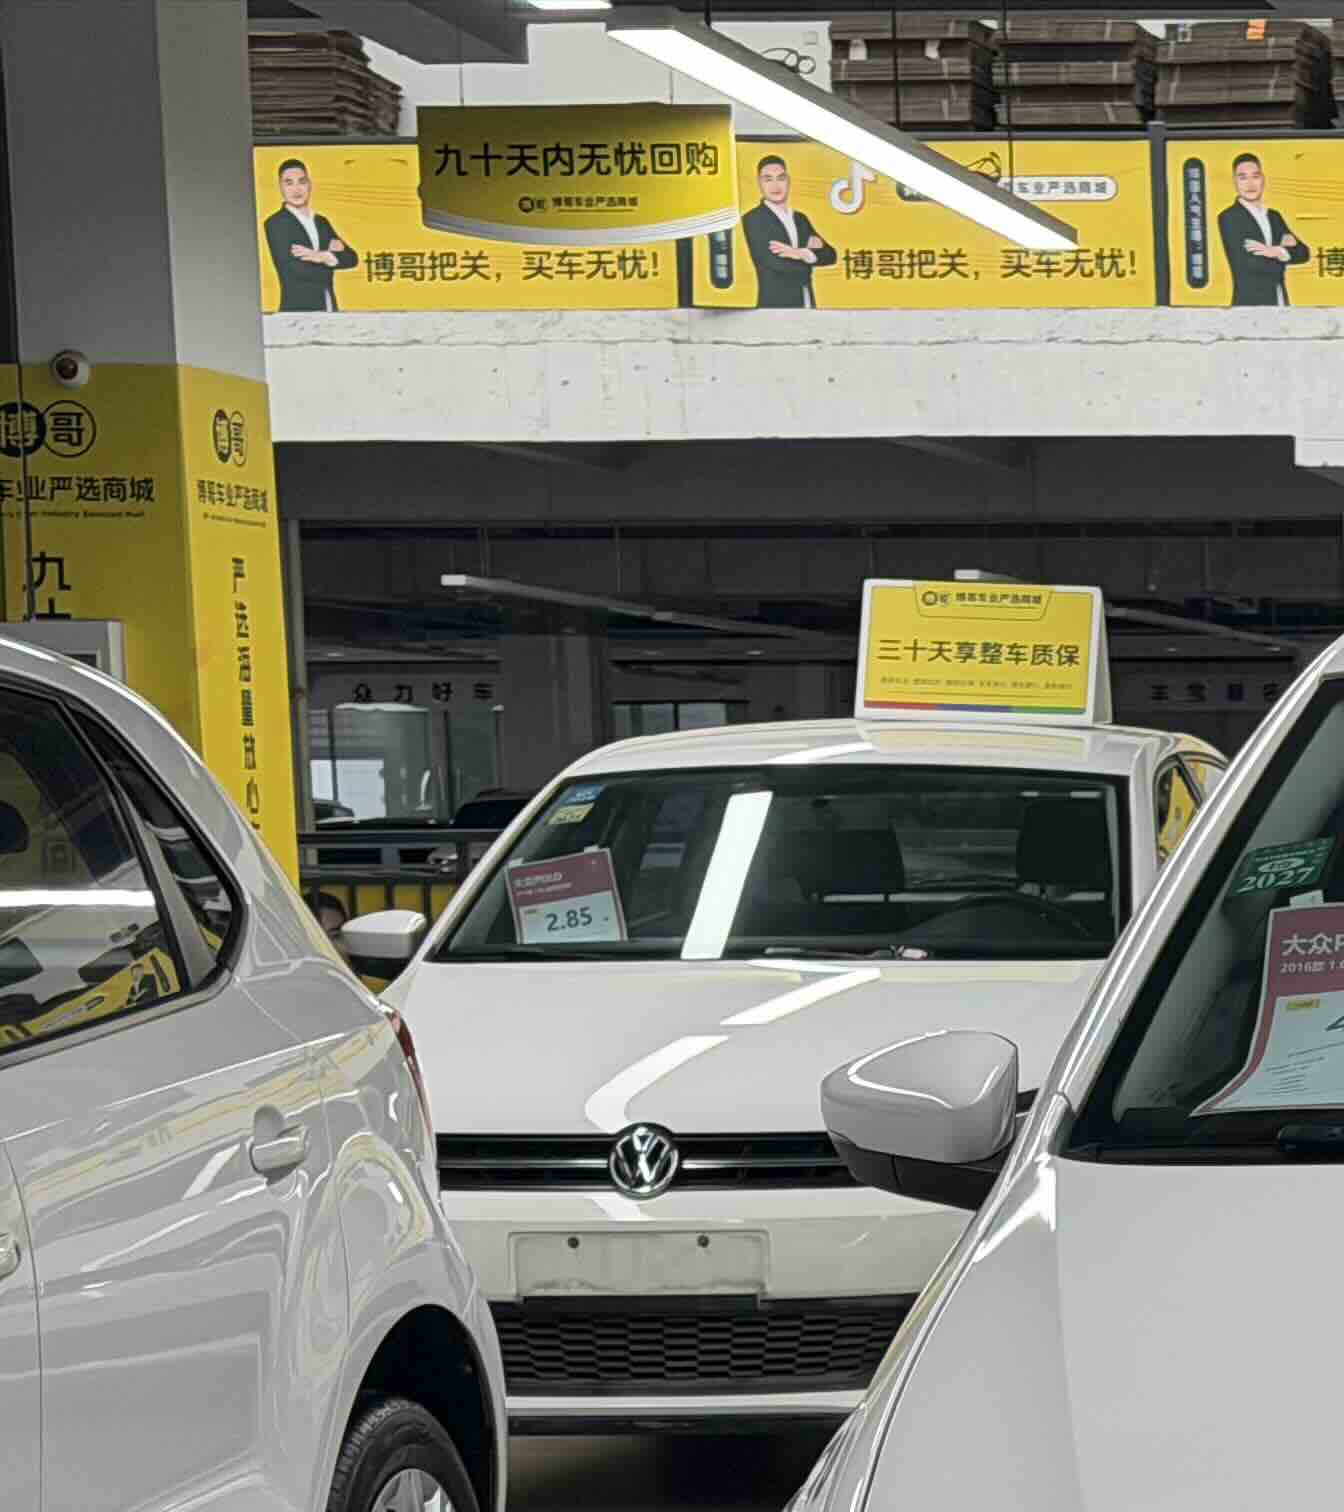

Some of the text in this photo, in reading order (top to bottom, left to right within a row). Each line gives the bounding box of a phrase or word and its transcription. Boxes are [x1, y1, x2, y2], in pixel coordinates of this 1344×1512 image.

[433, 142, 719, 178] 九十天内无忧回购
[876, 639, 1081, 667] 三十天享整车质保
[546, 906, 593, 932] 2.85
